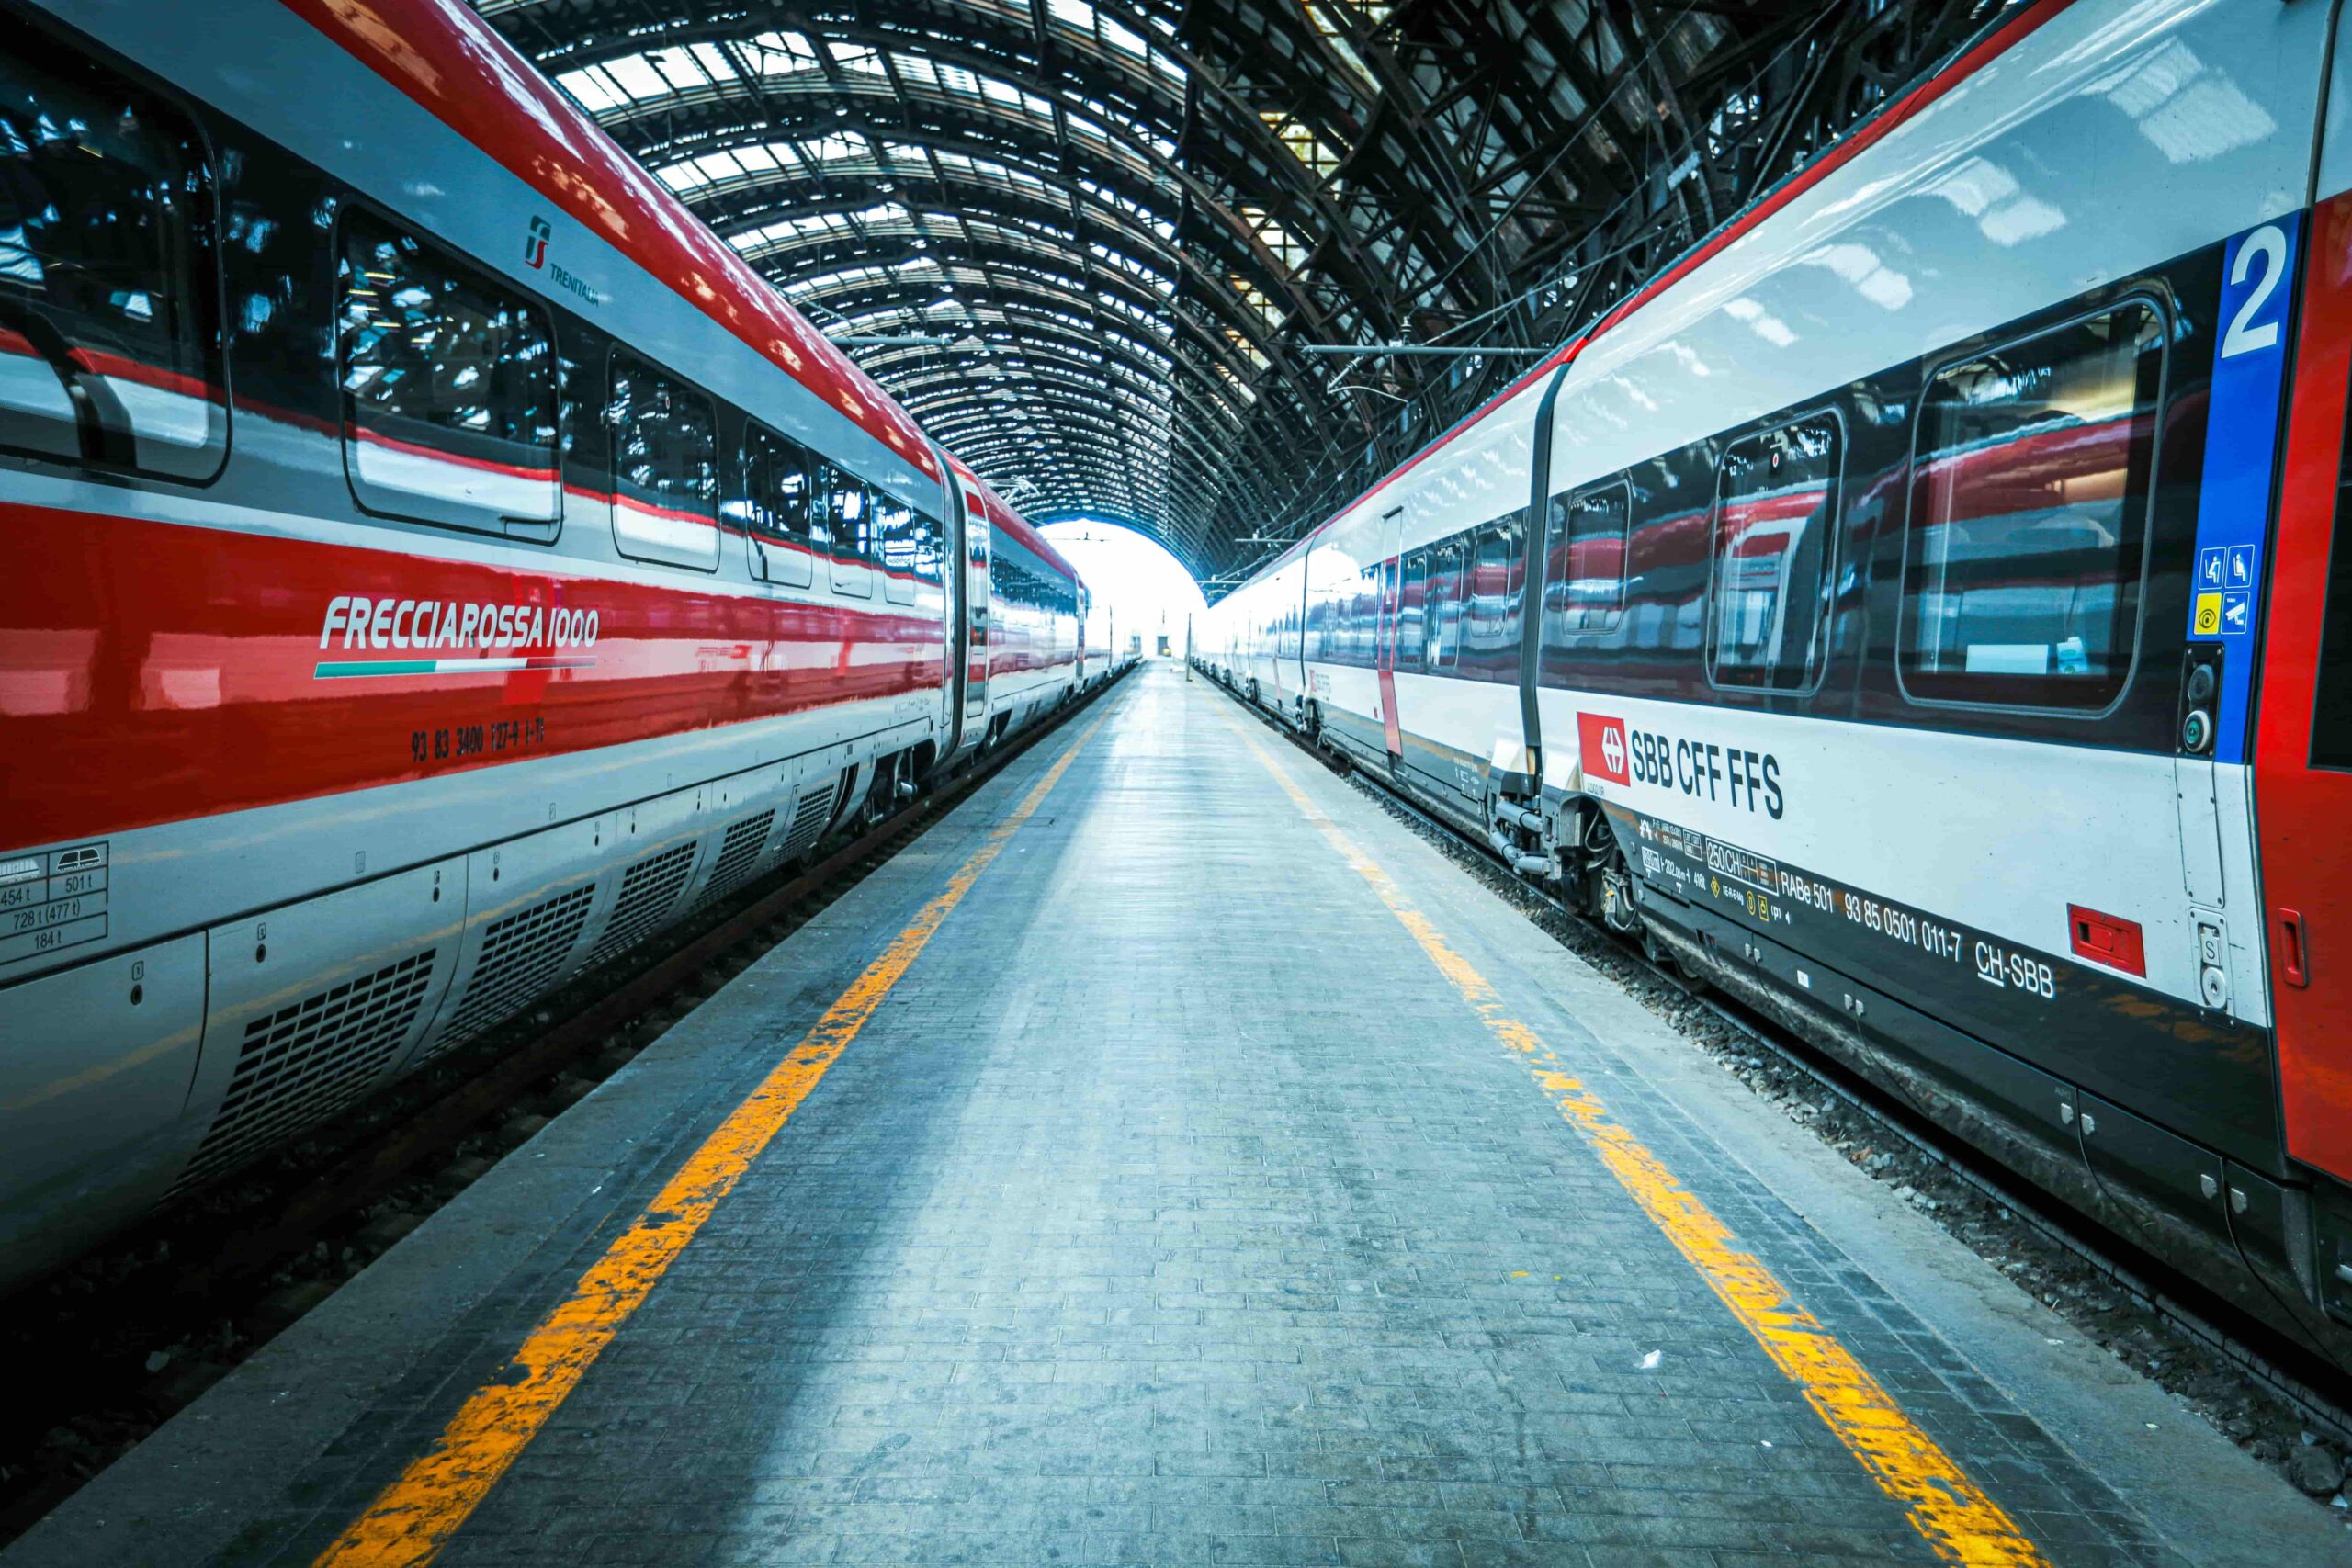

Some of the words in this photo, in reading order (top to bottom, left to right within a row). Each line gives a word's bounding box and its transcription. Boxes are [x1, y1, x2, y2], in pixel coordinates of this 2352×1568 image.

[2221, 225, 2287, 359] 2
[320, 596, 543, 649] FRECCIAROSSA
[547, 609, 599, 649] 1000
[412, 731, 427, 762] 93
[435, 728, 449, 759] 83
[1632, 729, 1673, 788] SBB
[1677, 738, 1722, 801] CFF
[1726, 748, 1783, 820] FFS
[1725, 849, 1740, 876] CH
[1, 887, 22, 906] 454
[26, 887, 30, 901] t
[65, 875, 84, 893] 501
[88, 874, 92, 888] t
[14, 910, 35, 930] 728
[38, 909, 42, 924] t
[45, 903, 70, 924] (477
[73, 897, 81, 917] t)
[34, 931, 54, 949] 184
[57, 930, 62, 944] t
[1781, 871, 1812, 905] RABe
[1813, 883, 1834, 914] 501
[1844, 893, 1861, 923] 93
[1864, 899, 1881, 931] 85
[1883, 907, 1917, 945] 0501
[1922, 921, 1962, 962] 011-7
[1975, 942, 2055, 999] CH-SBB
[2205, 941, 2216, 960] S
